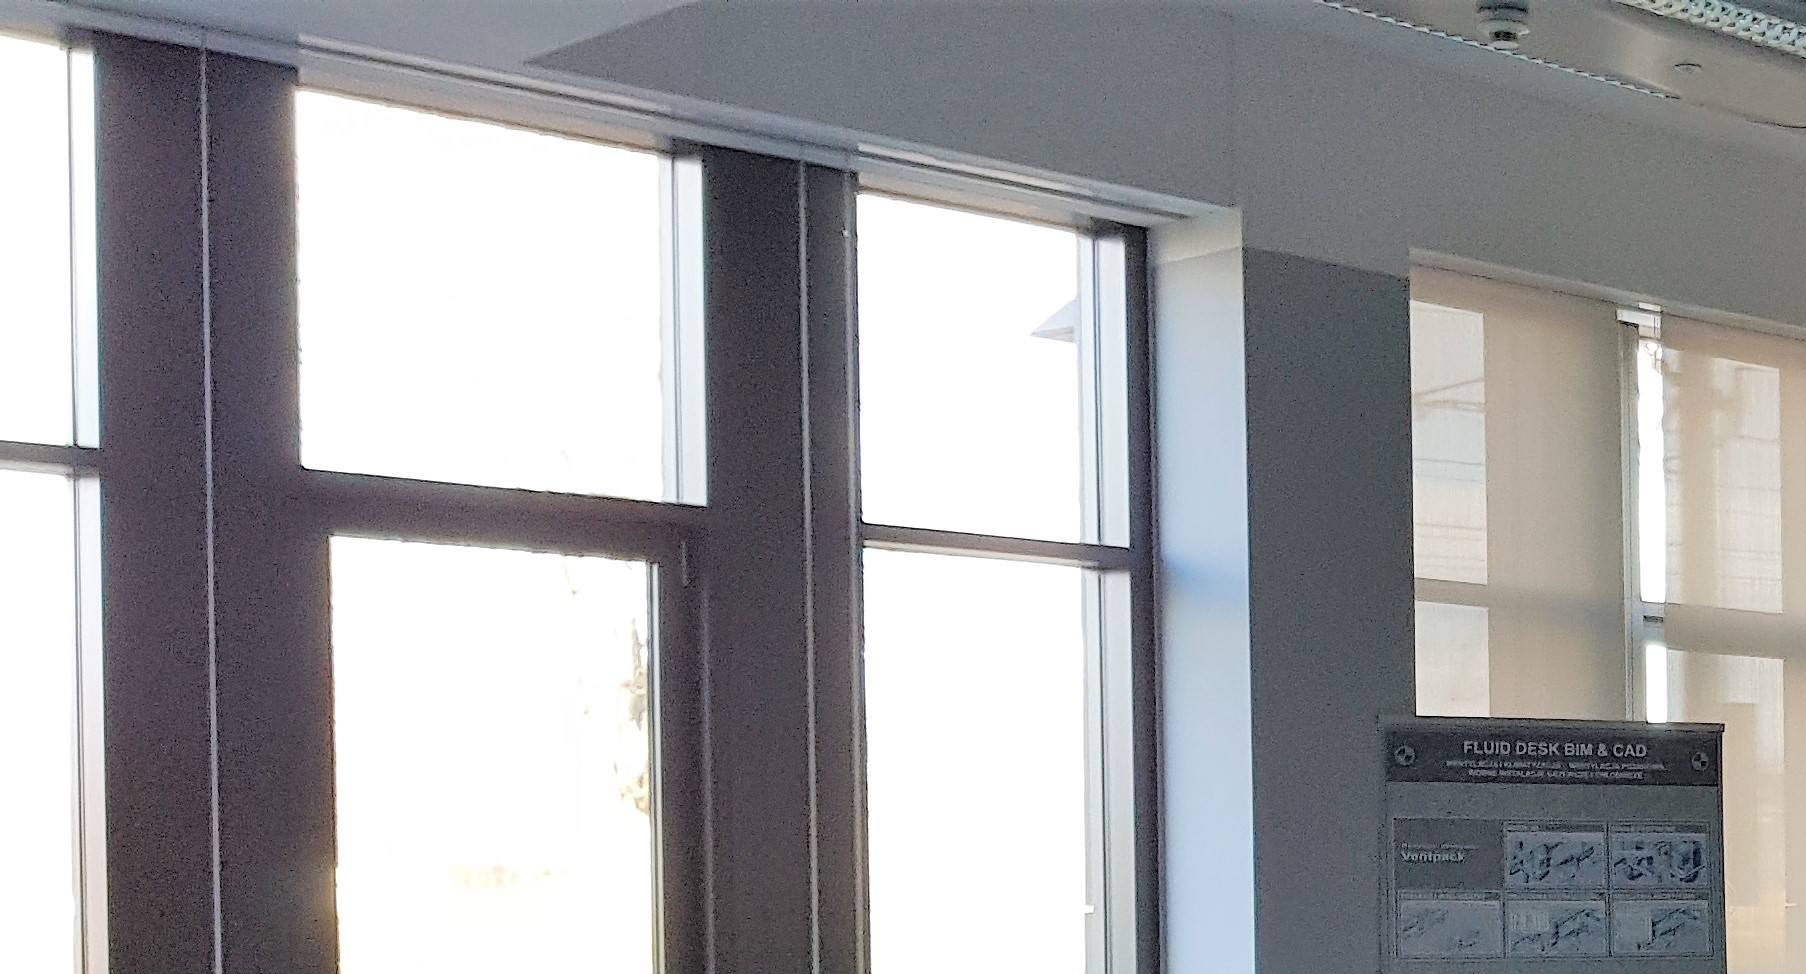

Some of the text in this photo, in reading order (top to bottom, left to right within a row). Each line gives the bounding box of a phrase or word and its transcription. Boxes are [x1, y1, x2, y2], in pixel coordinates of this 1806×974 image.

[1463, 740, 1648, 758] FLUID DESK BIM & CAD
